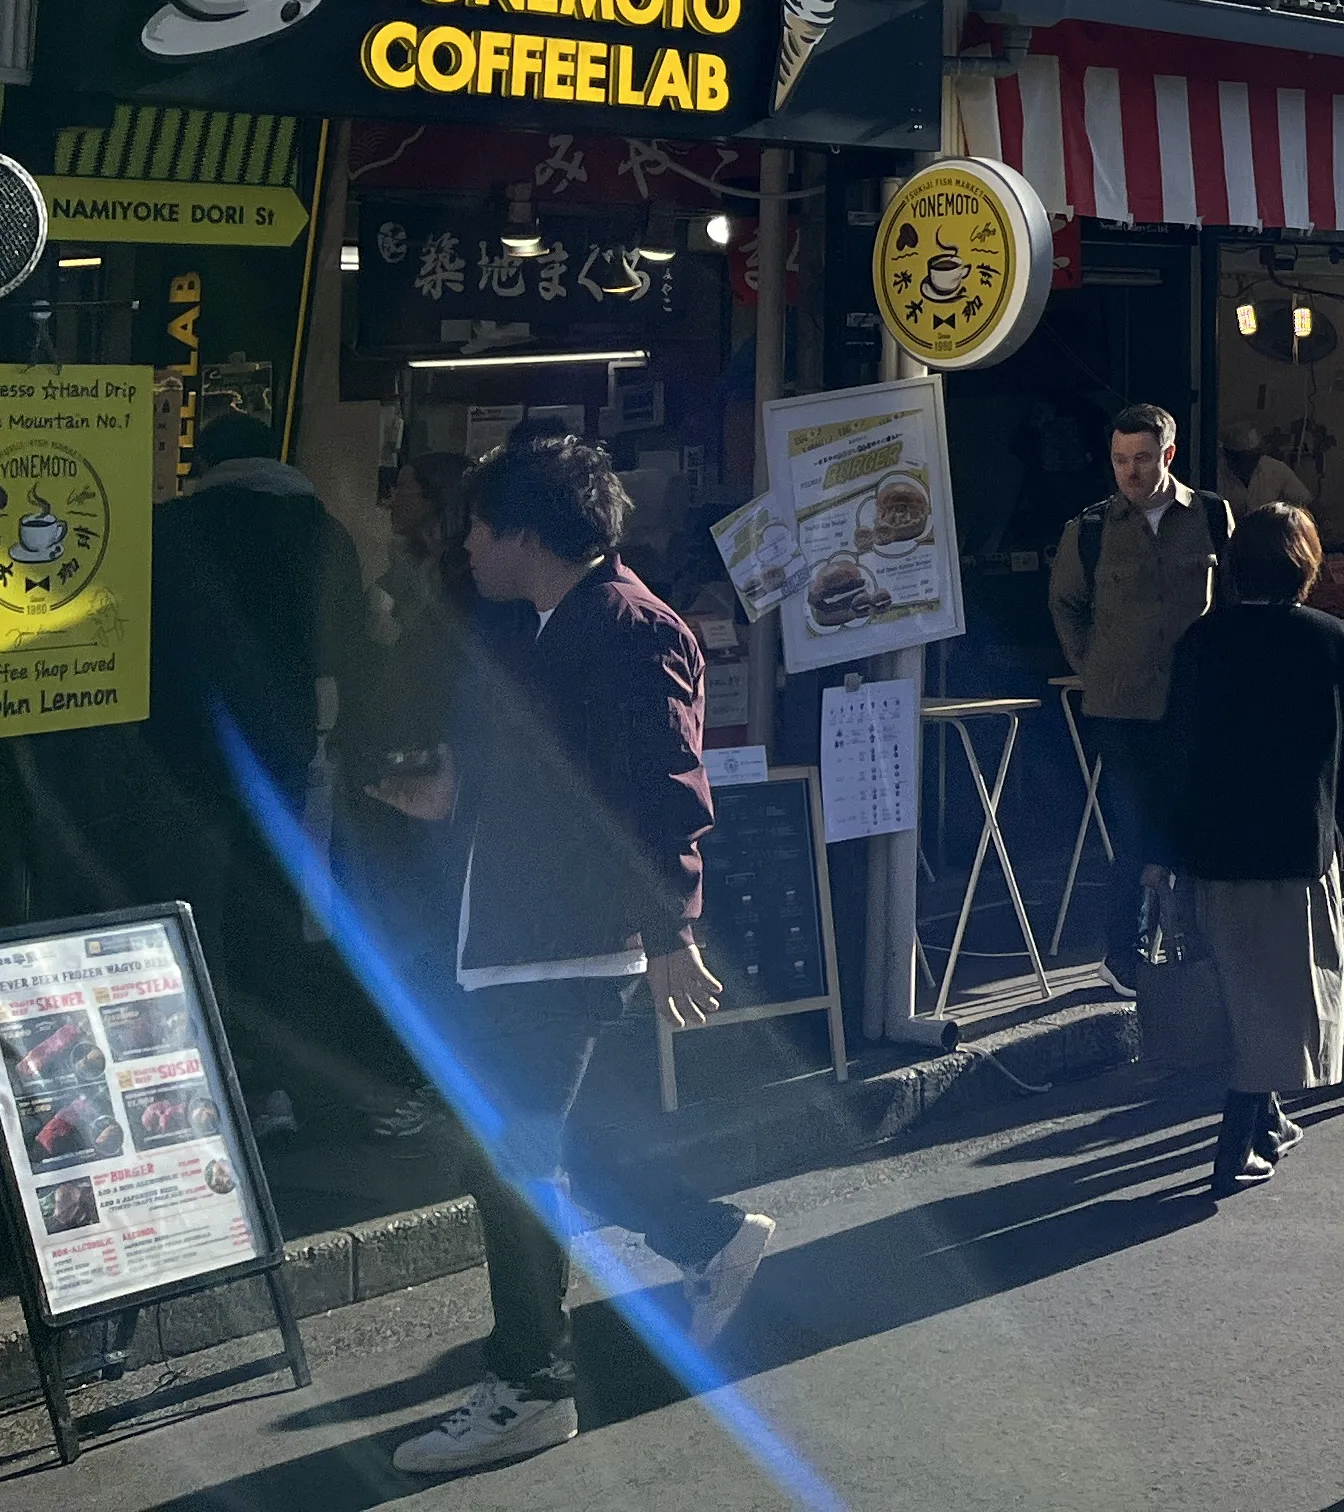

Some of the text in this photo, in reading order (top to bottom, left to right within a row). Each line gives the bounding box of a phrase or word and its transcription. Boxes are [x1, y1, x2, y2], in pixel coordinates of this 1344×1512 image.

[935, 177, 953, 186] FISH
[52, 197, 276, 226] NAMIYOKE DORI St
[910, 192, 979, 219] YONEMOTO
[167, 271, 201, 376] LAB
[105, 381, 137, 404] Drip
[9, 412, 131, 430] Mountain No.1
[0, 454, 79, 479] YONEMOTO
[827, 442, 901, 487] BURGER
[34, 659, 69, 682] Shop
[74, 652, 116, 676] Loved
[40, 686, 119, 714] Lennon
[62, 967, 104, 983] FROZEN
[135, 975, 181, 996] STEAK
[36, 991, 84, 1012] SKEWER
[158, 1058, 200, 1080] SUSHI
[109, 1162, 155, 1183] BURGER
